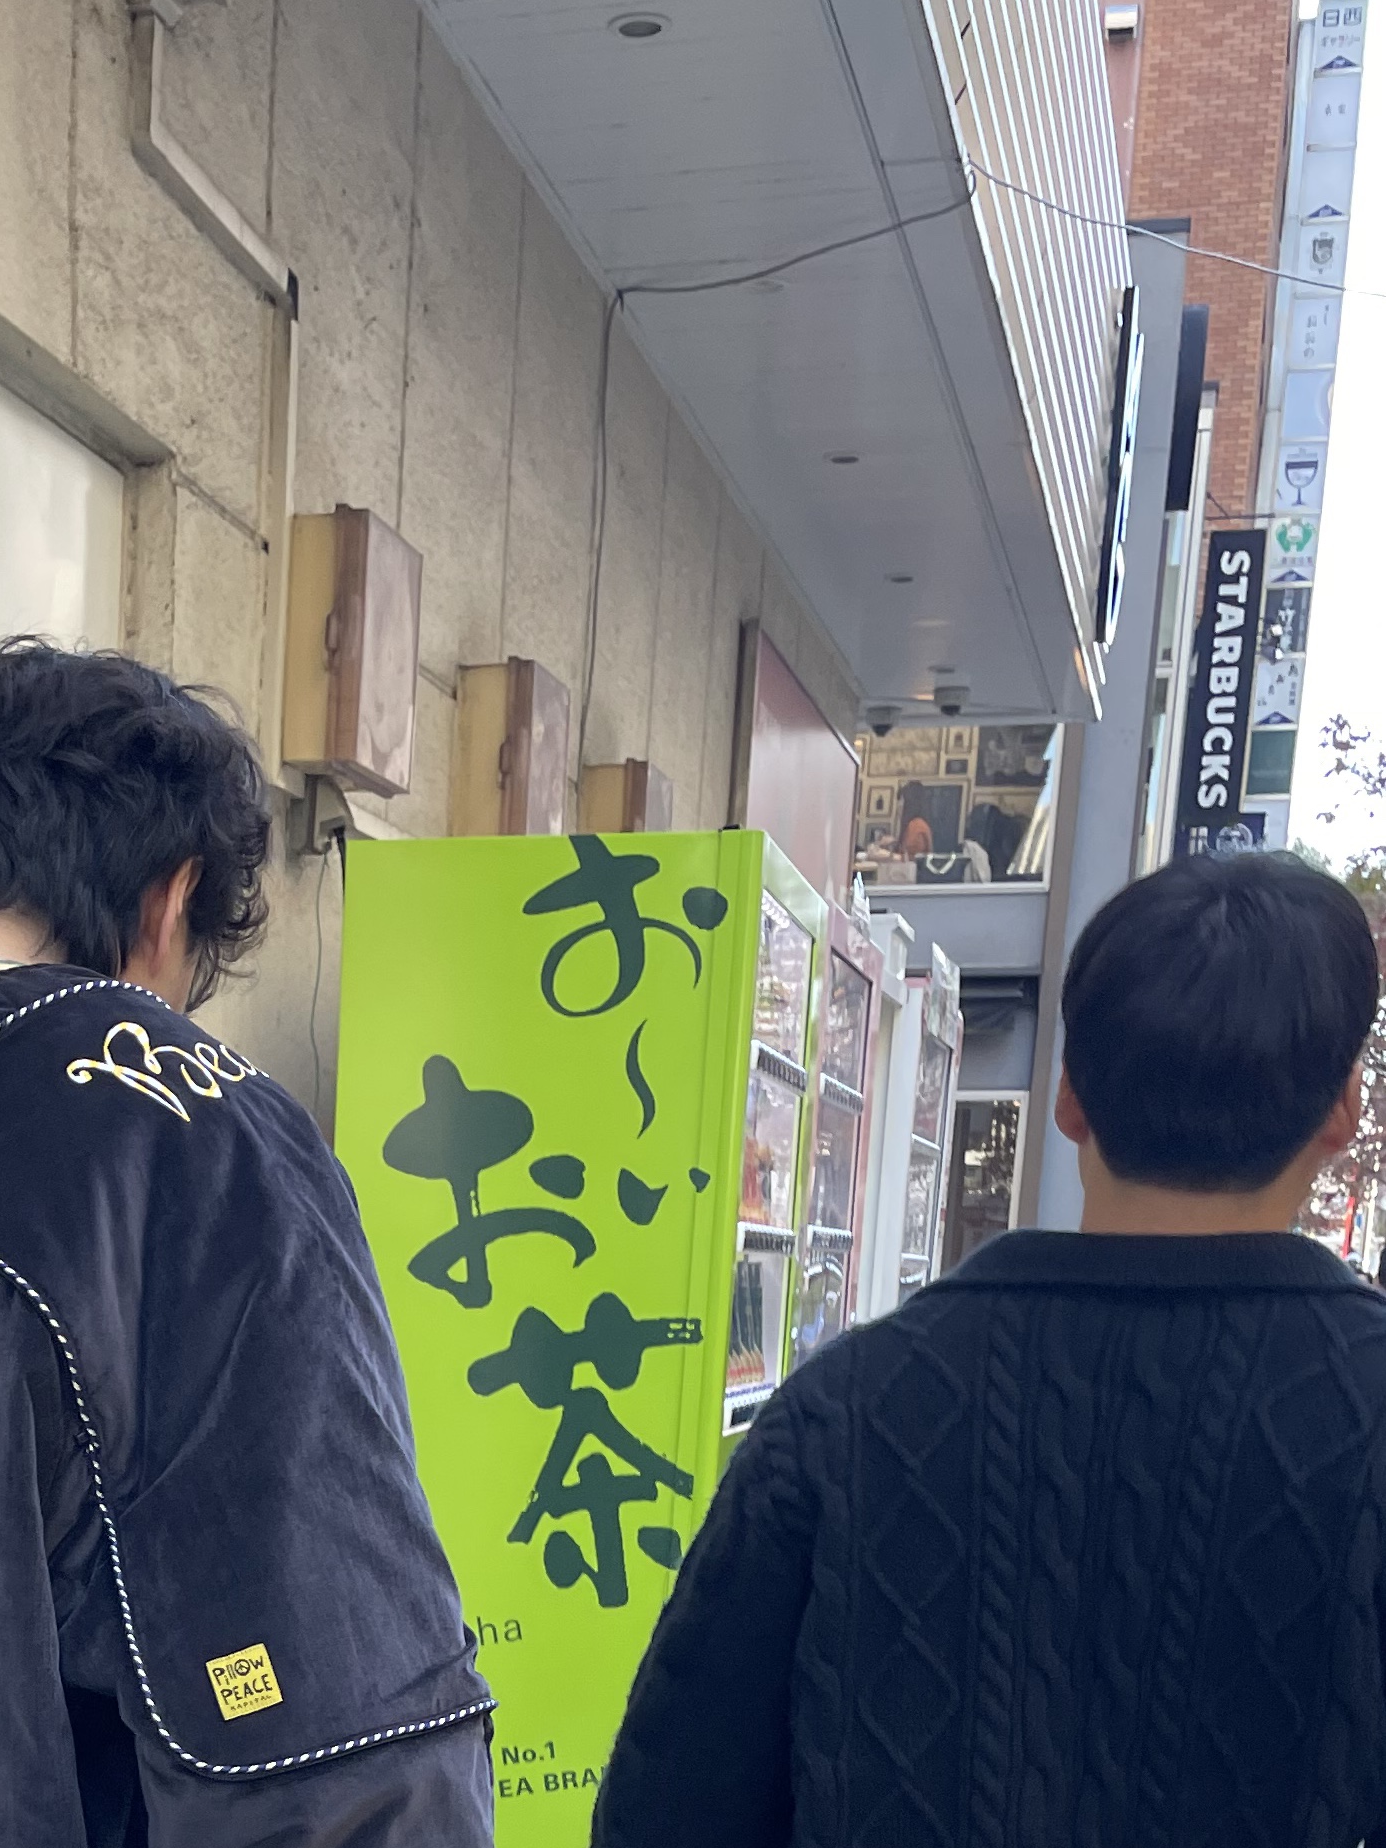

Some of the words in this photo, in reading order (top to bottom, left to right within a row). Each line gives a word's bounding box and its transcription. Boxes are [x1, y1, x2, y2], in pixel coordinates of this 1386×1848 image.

[1197, 550, 1252, 809] STARBUCKS
[477, 1616, 523, 1646] ha
[220, 1674, 273, 1705] PEACE
[501, 1741, 556, 1766] No.1
[498, 1776, 534, 1798] EA
